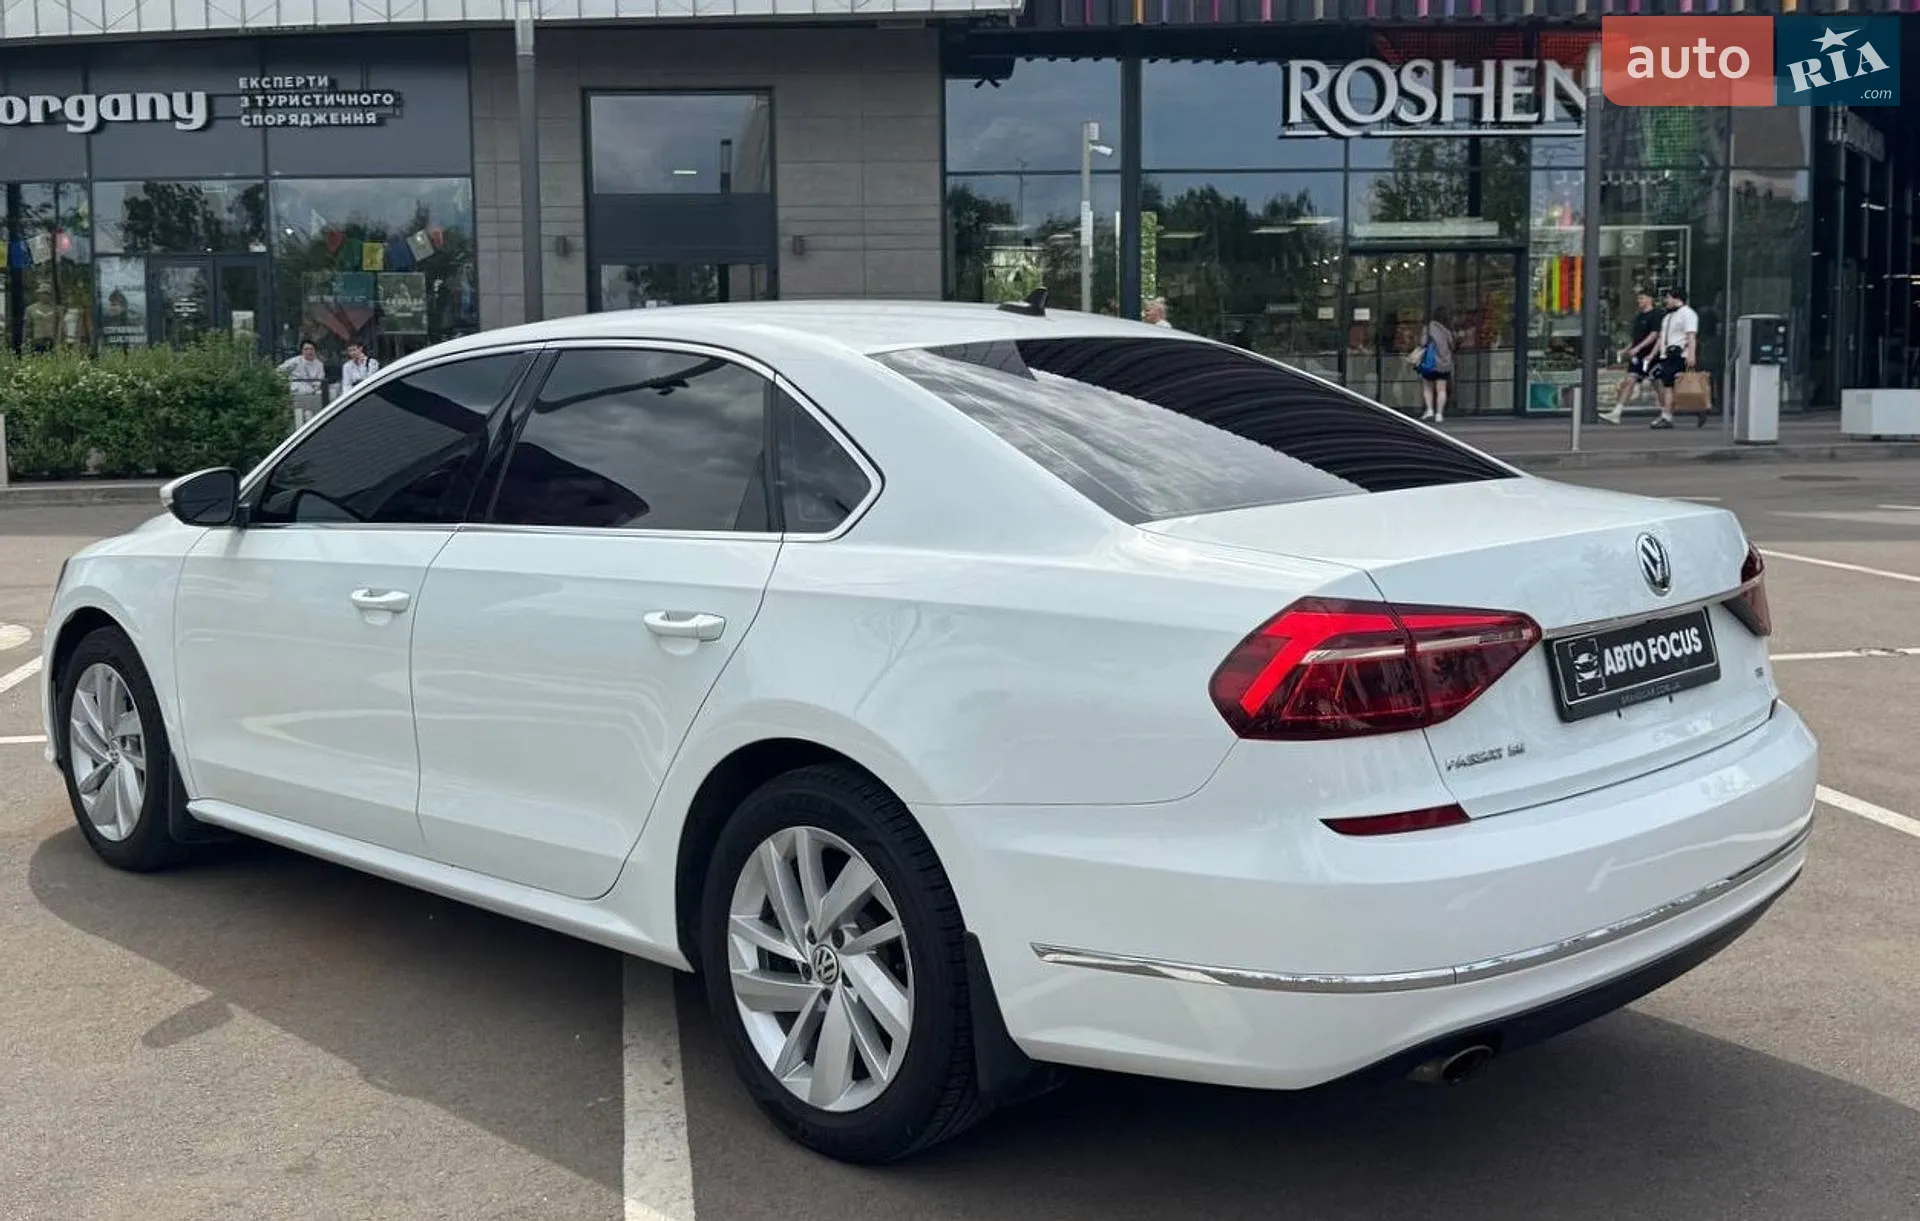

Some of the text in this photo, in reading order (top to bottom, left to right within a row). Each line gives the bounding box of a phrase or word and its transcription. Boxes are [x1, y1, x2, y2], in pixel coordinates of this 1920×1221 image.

[238, 75, 329, 89] ЕКСПЕРТИ
[256, 93, 395, 107] ТУРИСТИЧНОГО
[1287, 58, 1587, 136] ROSHEN
[240, 112, 377, 128] СПОРЯДЖЕННЯ
[1647, 626, 1703, 664] FOCUS
